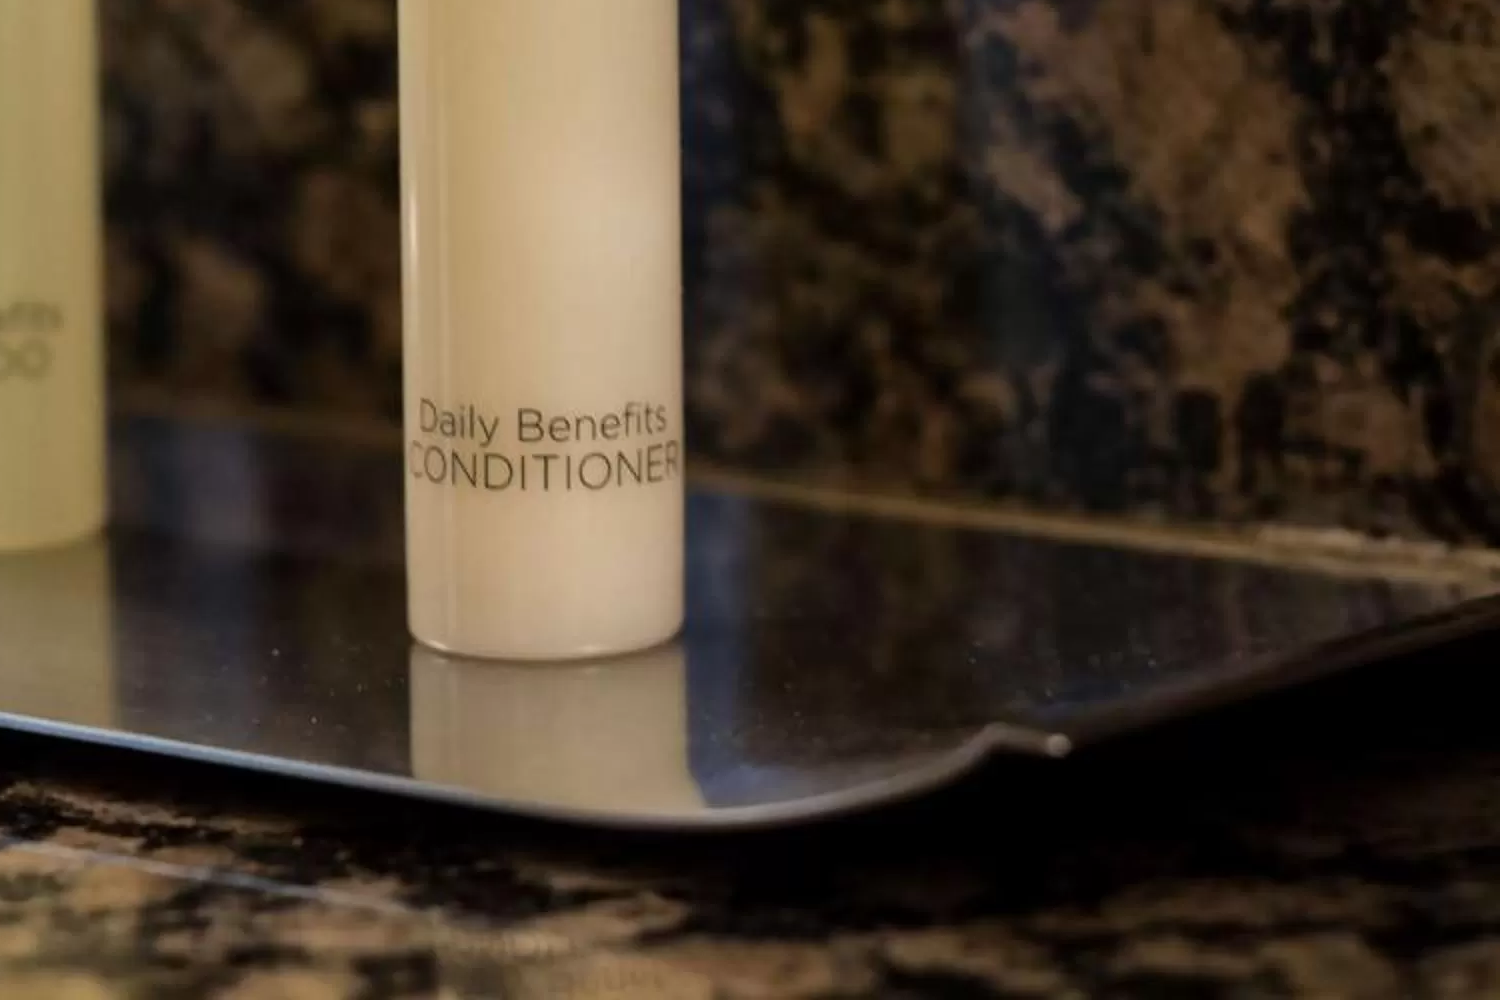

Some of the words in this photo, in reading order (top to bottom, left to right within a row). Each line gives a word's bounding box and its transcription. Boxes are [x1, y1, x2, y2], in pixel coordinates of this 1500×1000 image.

[419, 397, 499, 447] Daily
[517, 402, 667, 443] Benefits
[409, 440, 680, 491] CONDITIONER
